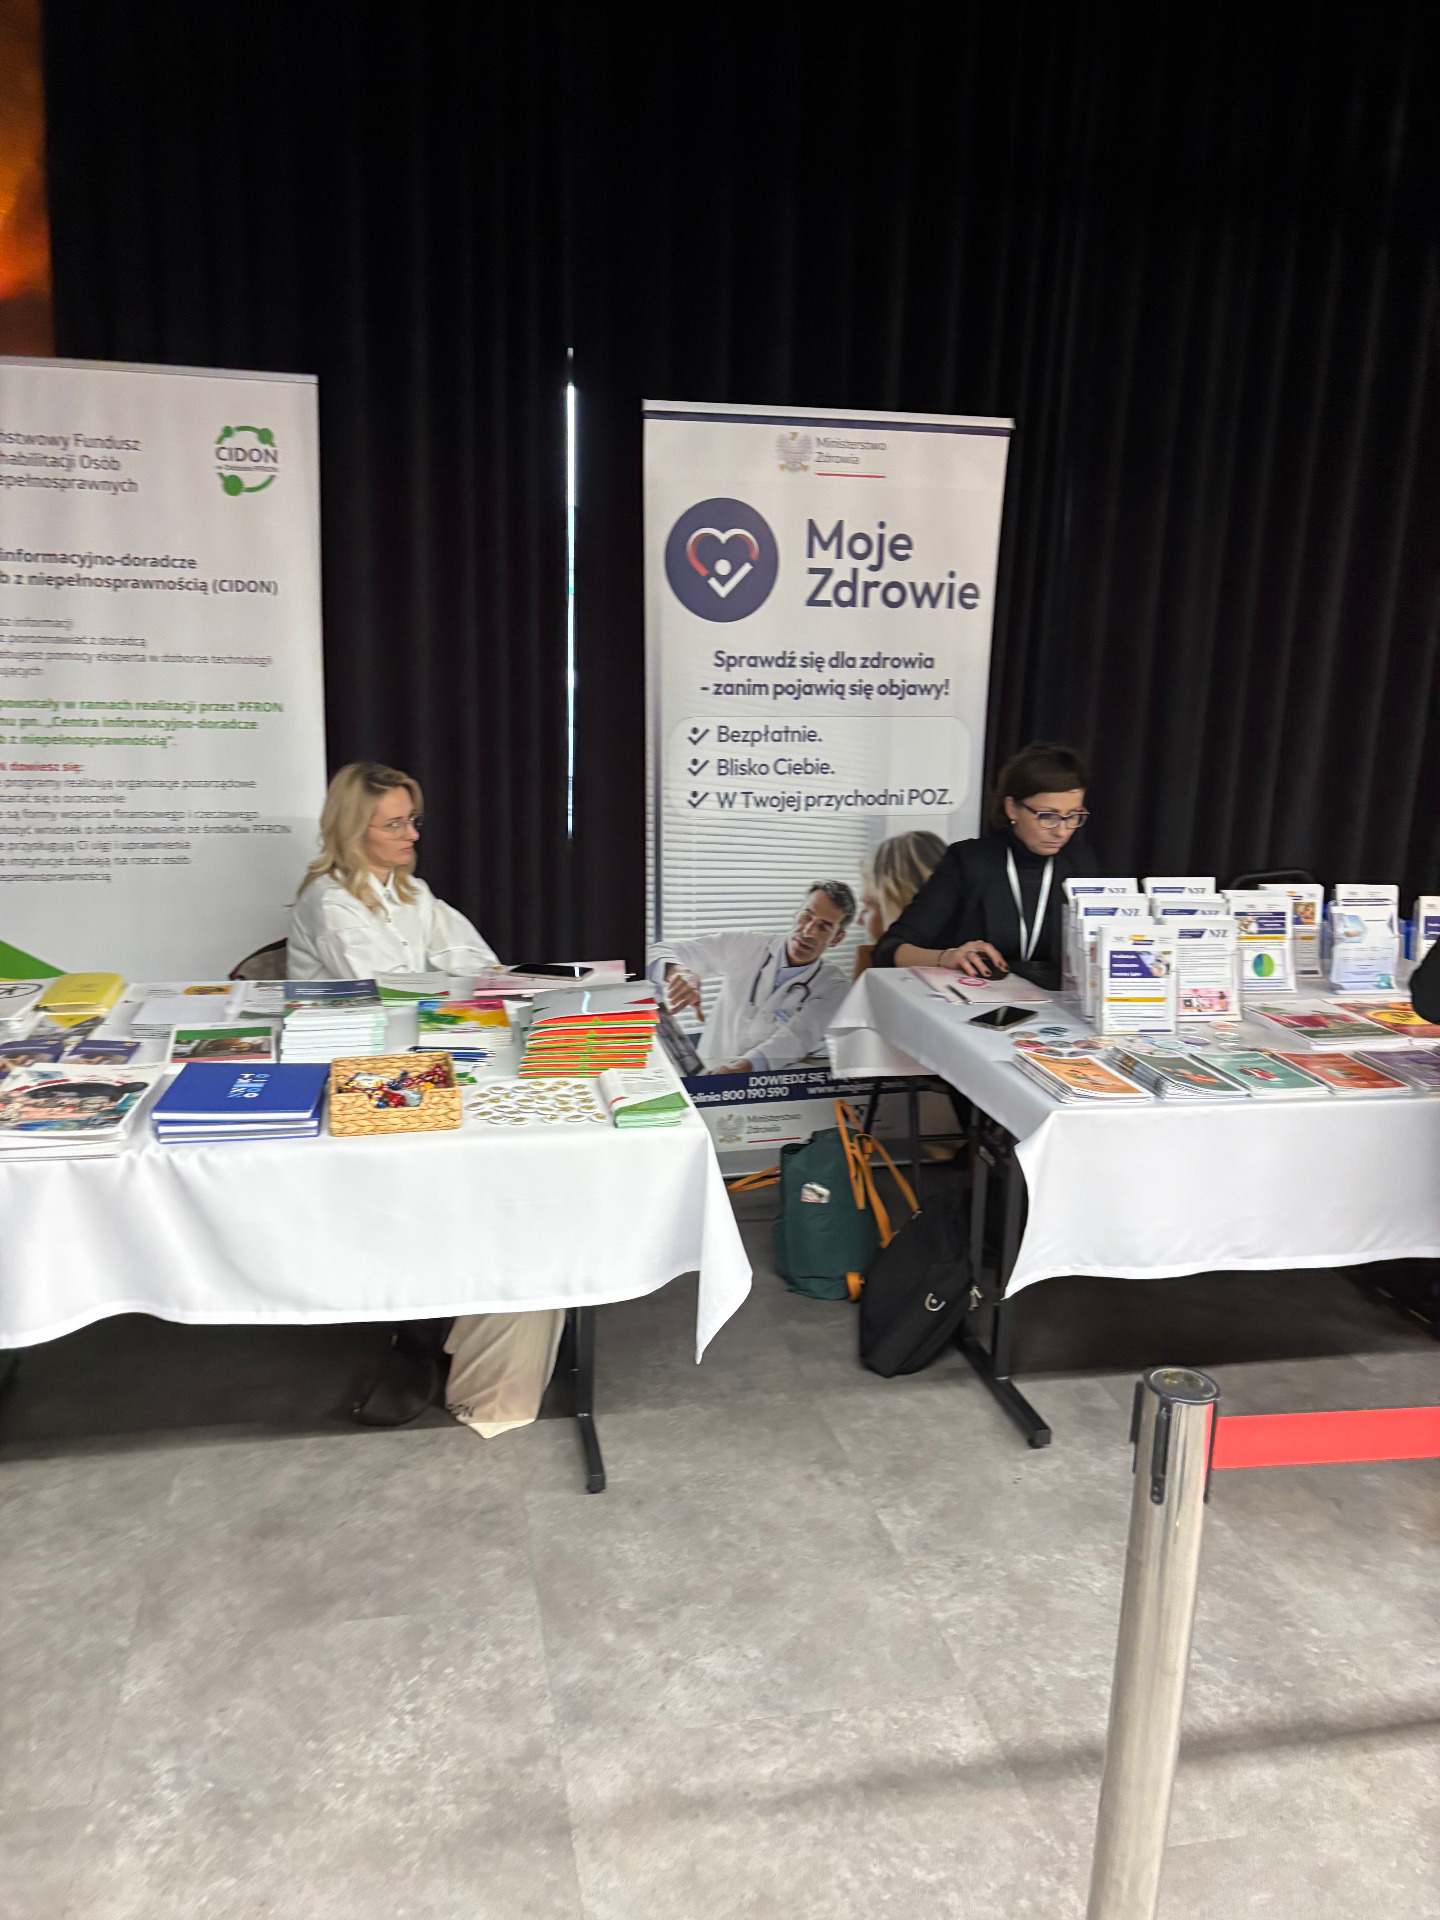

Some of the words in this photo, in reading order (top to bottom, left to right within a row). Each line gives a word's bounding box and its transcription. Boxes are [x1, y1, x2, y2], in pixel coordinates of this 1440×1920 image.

[74, 433, 141, 451] Fundusz
[816, 437, 886, 450] Ministerstwo
[80, 453, 121, 471] Osób
[215, 446, 279, 464] CIDON
[815, 451, 860, 464] Zdrowia
[807, 518, 914, 572] Moje
[28, 572, 209, 595] niepełnosprawnością
[212, 578, 279, 596] (CIDON)
[805, 567, 981, 610] Zdrowie
[713, 650, 798, 672] Sprawdź
[800, 652, 825, 673] się
[828, 651, 858, 670] dla
[860, 652, 935, 671] zdrowia
[713, 679, 770, 697] zanim
[772, 680, 847, 700] pojawią
[849, 680, 874, 700] się
[877, 679, 950, 700] objawy!
[717, 725, 823, 747] Bezpłatnie.
[717, 758, 770, 776] Blisko
[773, 758, 836, 776] Ciebie.
[717, 791, 737, 809] W
[740, 791, 801, 813] Twojej
[804, 789, 905, 811] przychodni
[908, 788, 953, 806] POZ.
[749, 1073, 806, 1087] DOWIEDZ
[807, 1071, 826, 1085] SIĘ
[722, 1089, 745, 1101] 800
[747, 1087, 766, 1099] 190
[766, 1086, 789, 1098] 590
